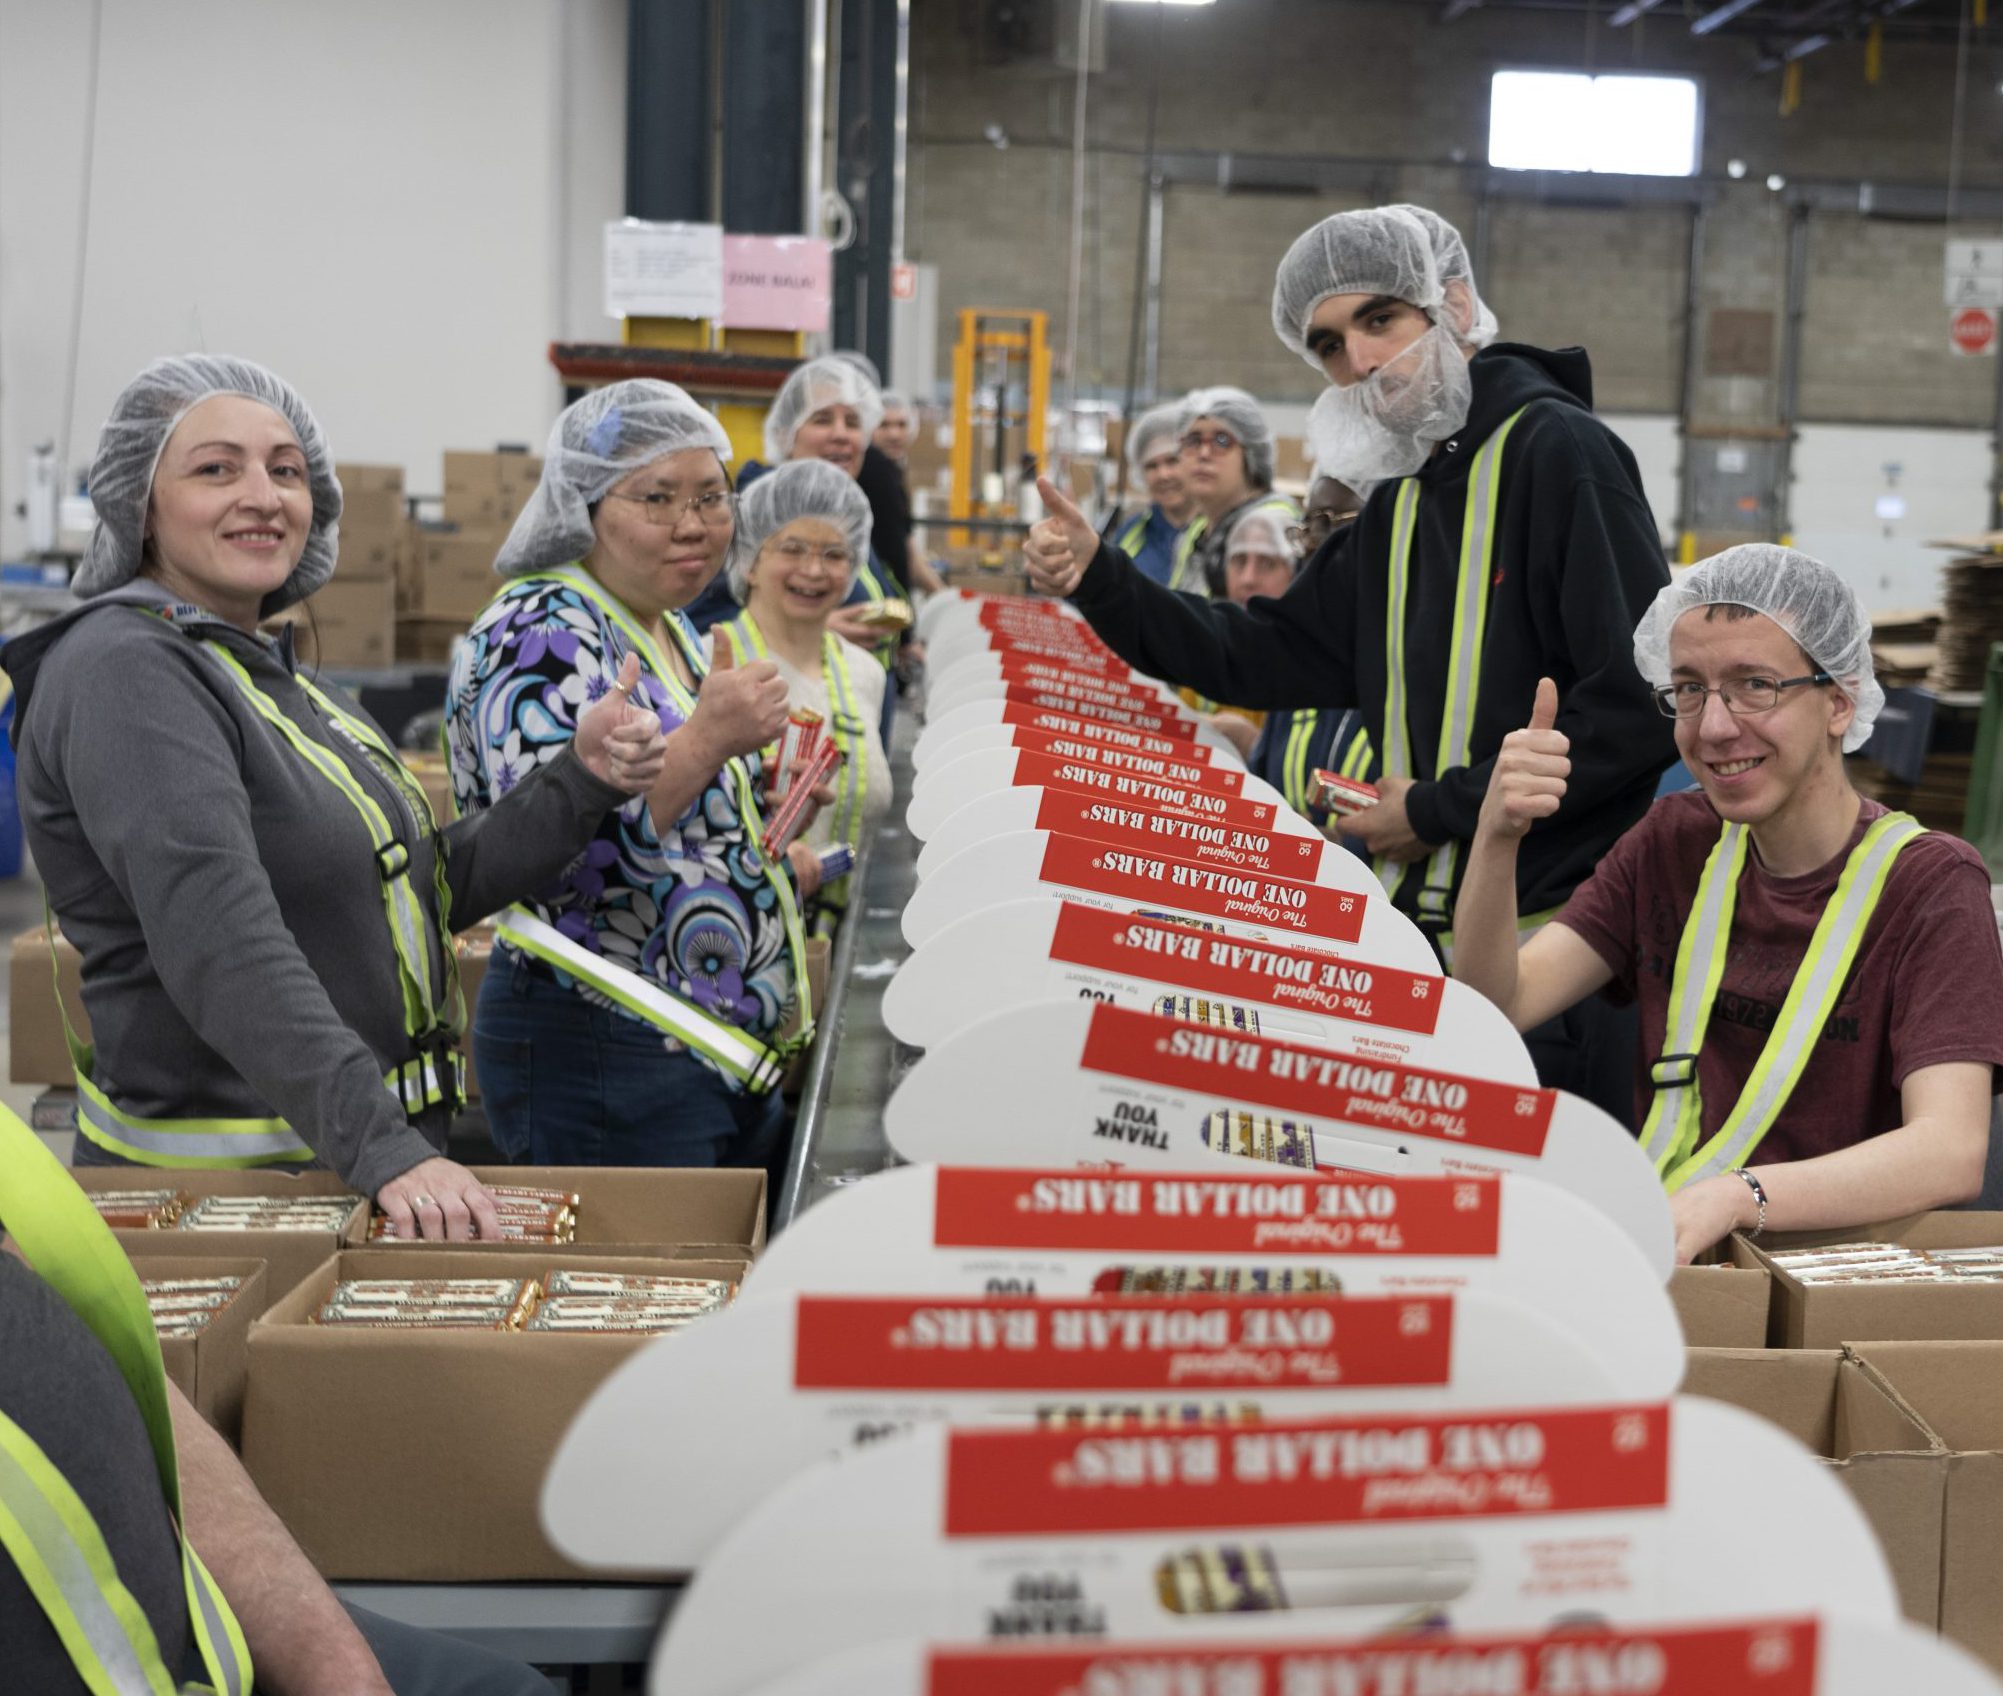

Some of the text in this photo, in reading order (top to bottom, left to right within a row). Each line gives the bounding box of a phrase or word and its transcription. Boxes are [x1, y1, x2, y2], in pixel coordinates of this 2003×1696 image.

[1083, 723, 1140, 747] DOLLAR
[1142, 737, 1173, 754] ONE
[1101, 749, 1164, 774] DOLLAR
[1167, 763, 1200, 782] ONE
[1116, 776, 1186, 805] DOLLAR
[1189, 793, 1226, 813] ONE
[1253, 809, 1266, 819] 60
[1150, 815, 1226, 844] DOLLAR
[1229, 831, 1269, 852] ONE
[1196, 844, 1269, 869] The Original
[1298, 846, 1311, 856] 60
[1171, 865, 1258, 899] DOLLAR
[1262, 883, 1306, 908] ONE
[1224, 899, 1306, 927] The Original
[1339, 902, 1353, 913] 60
[1209, 941, 1313, 982] DOLLAR
[1318, 964, 1372, 993] ONE
[1411, 986, 1428, 999] 60
[1272, 982, 1372, 1017] The Original
[1269, 1048, 1395, 1097] DOLLAR
[1400, 1075, 1467, 1109] ONE
[1114, 1102, 1158, 1127] YOU
[1344, 1093, 1465, 1136] The Original
[1514, 1101, 1537, 1117] 60
[1092, 1117, 1169, 1151] THANK
[1153, 1181, 1304, 1217] DOLLAR
[1316, 1184, 1395, 1218] ONE
[1254, 1216, 1402, 1248] The Original
[1052, 1310, 1233, 1350] DOLLAR
[1243, 1309, 1333, 1347] ONE
[1234, 1428, 1434, 1480] DOLLAR
[1442, 1425, 1544, 1471] ONE
